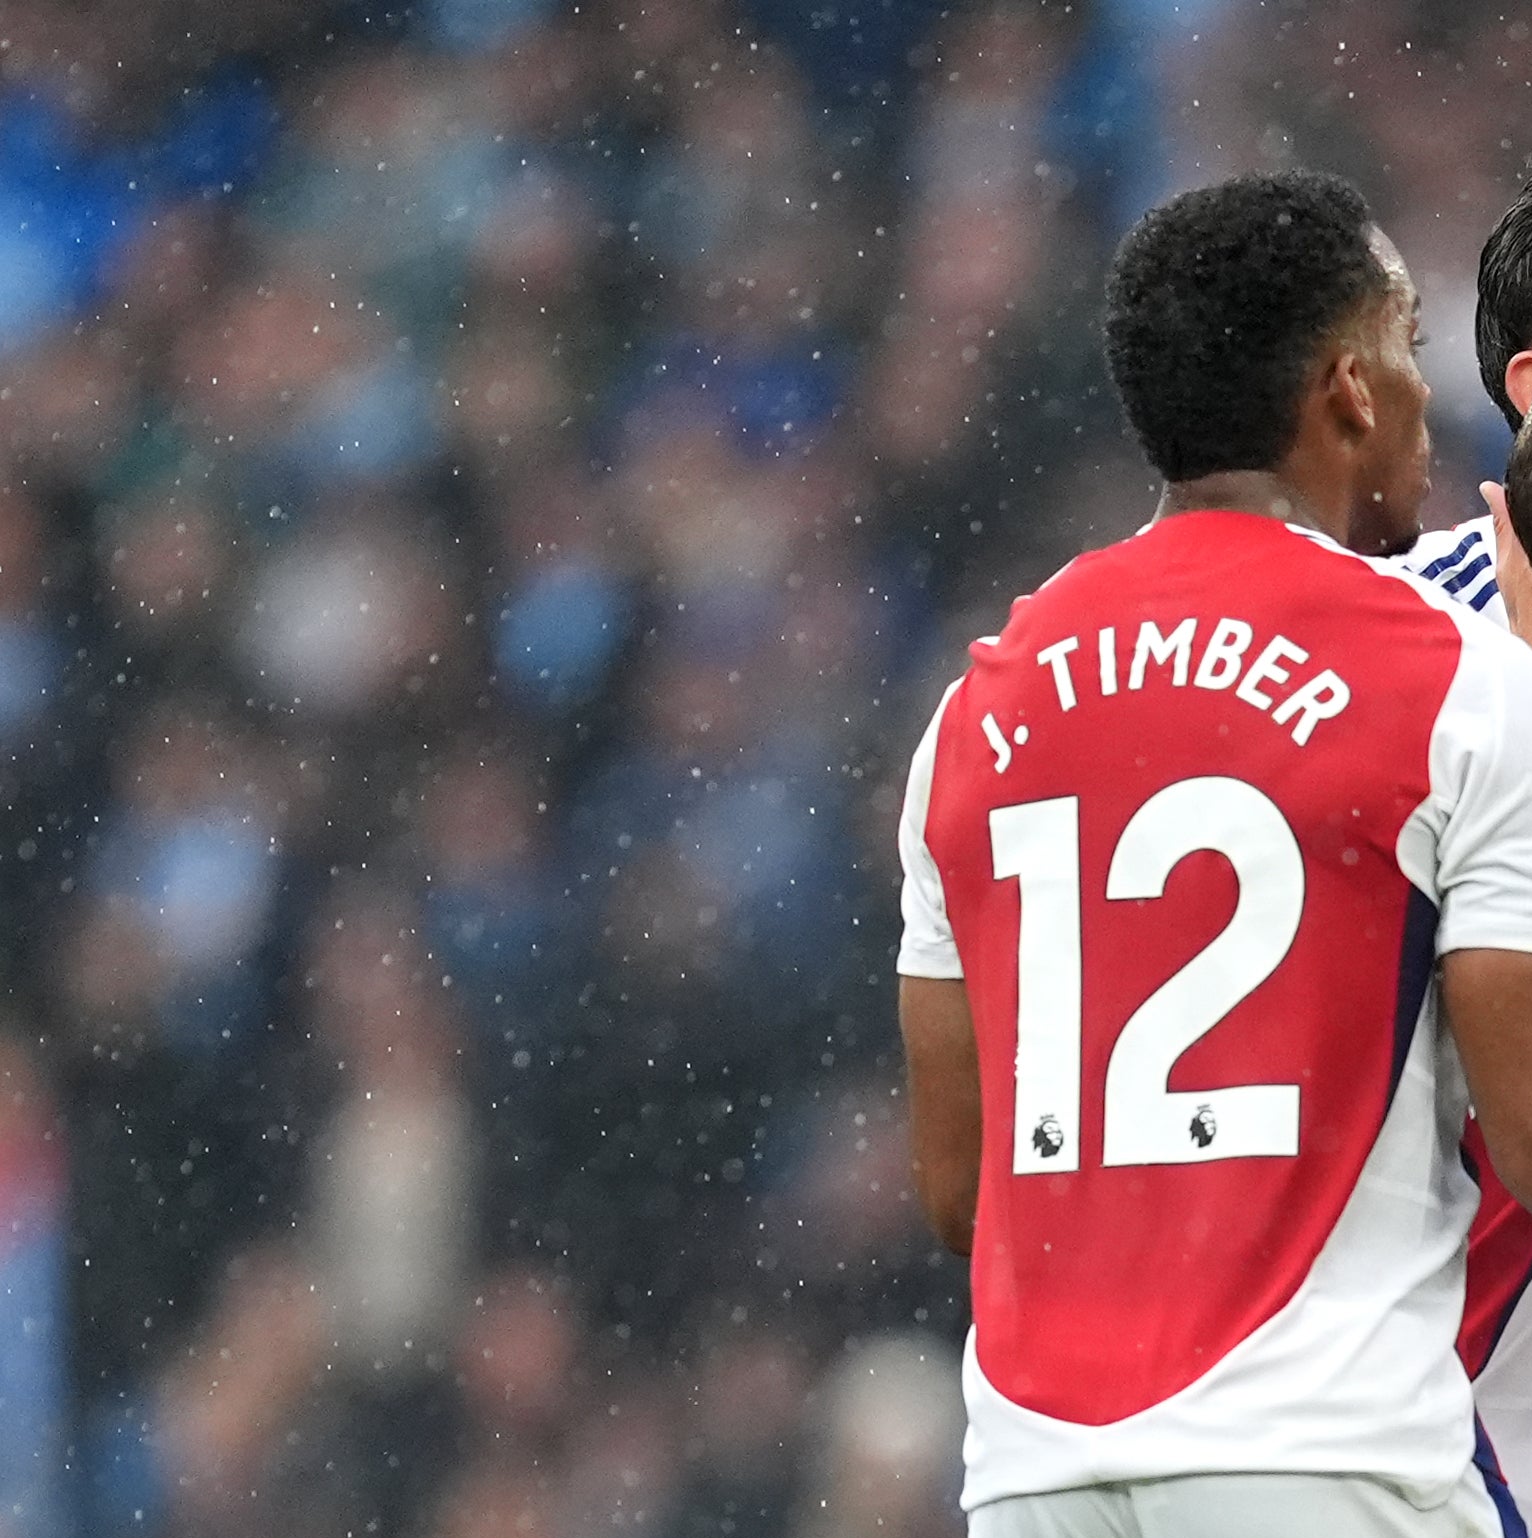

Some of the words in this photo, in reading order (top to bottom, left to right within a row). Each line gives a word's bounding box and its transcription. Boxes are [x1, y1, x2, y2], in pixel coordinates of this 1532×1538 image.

[982, 713, 1028, 773] J.
[1037, 618, 1350, 746] TIMBER
[986, 775, 1306, 1175] 12
